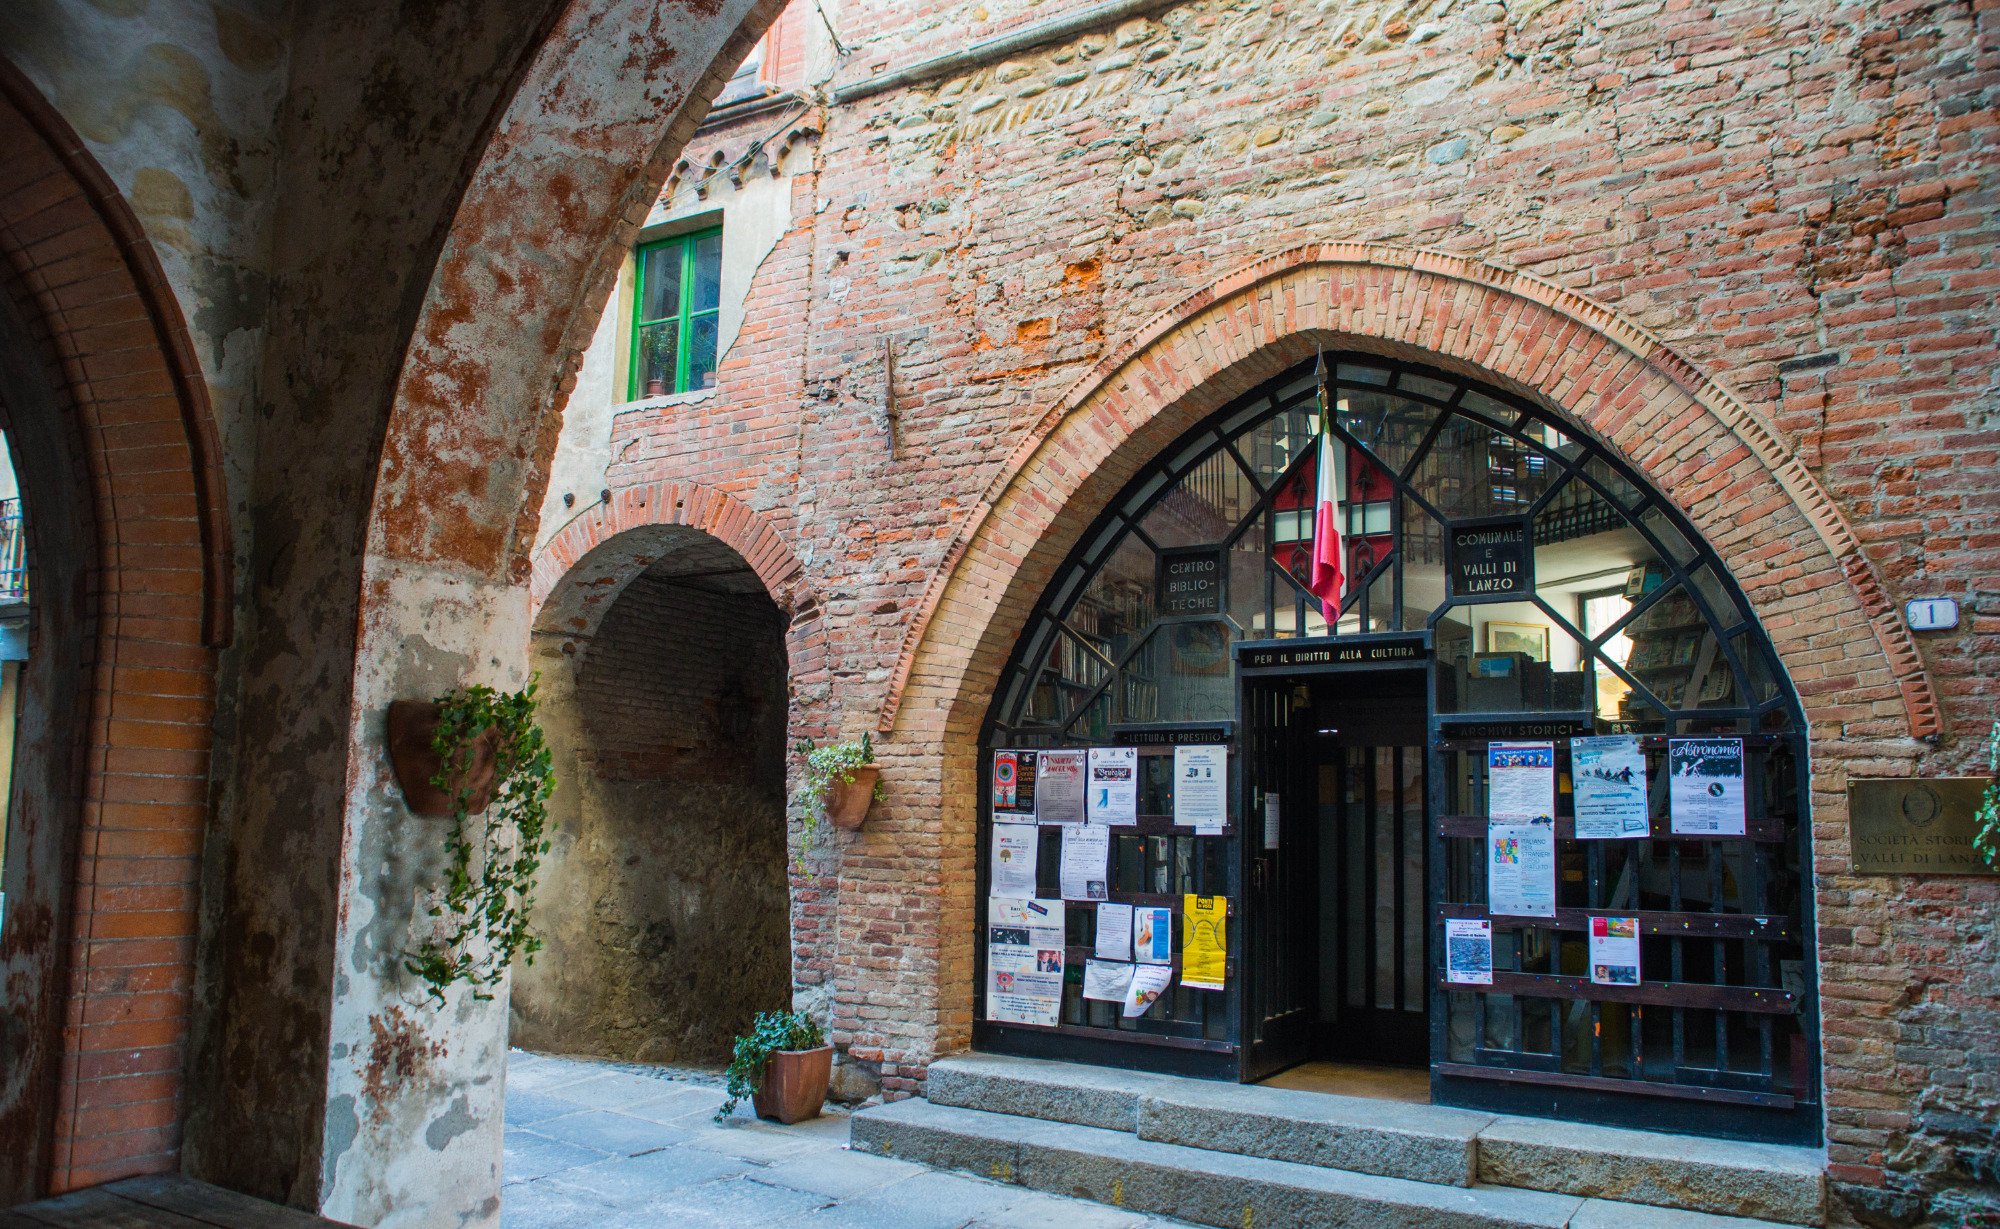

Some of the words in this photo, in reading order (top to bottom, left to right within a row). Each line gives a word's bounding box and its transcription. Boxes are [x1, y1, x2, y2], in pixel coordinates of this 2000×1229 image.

[1457, 530, 1523, 546] COMUNALE
[1485, 548, 1493, 558] E
[1170, 561, 1215, 574] CENTRO
[1463, 562, 1497, 576] VALLI
[1503, 561, 1517, 573] DI
[1469, 578, 1513, 592] LANZO
[1171, 596, 1214, 611] TECHE
[1927, 604, 1935, 624] 1
[1254, 654, 1273, 664] PER
[1280, 653, 1289, 663] IL
[1295, 651, 1330, 663] DIRITTO
[1339, 649, 1363, 660] ALLA
[1371, 647, 1415, 659] CULTURA
[1168, 733, 1175, 742] E
[1671, 741, 1741, 757] Astronomia
[1860, 853, 1904, 863] VALLI
[1913, 853, 1929, 863] DI
